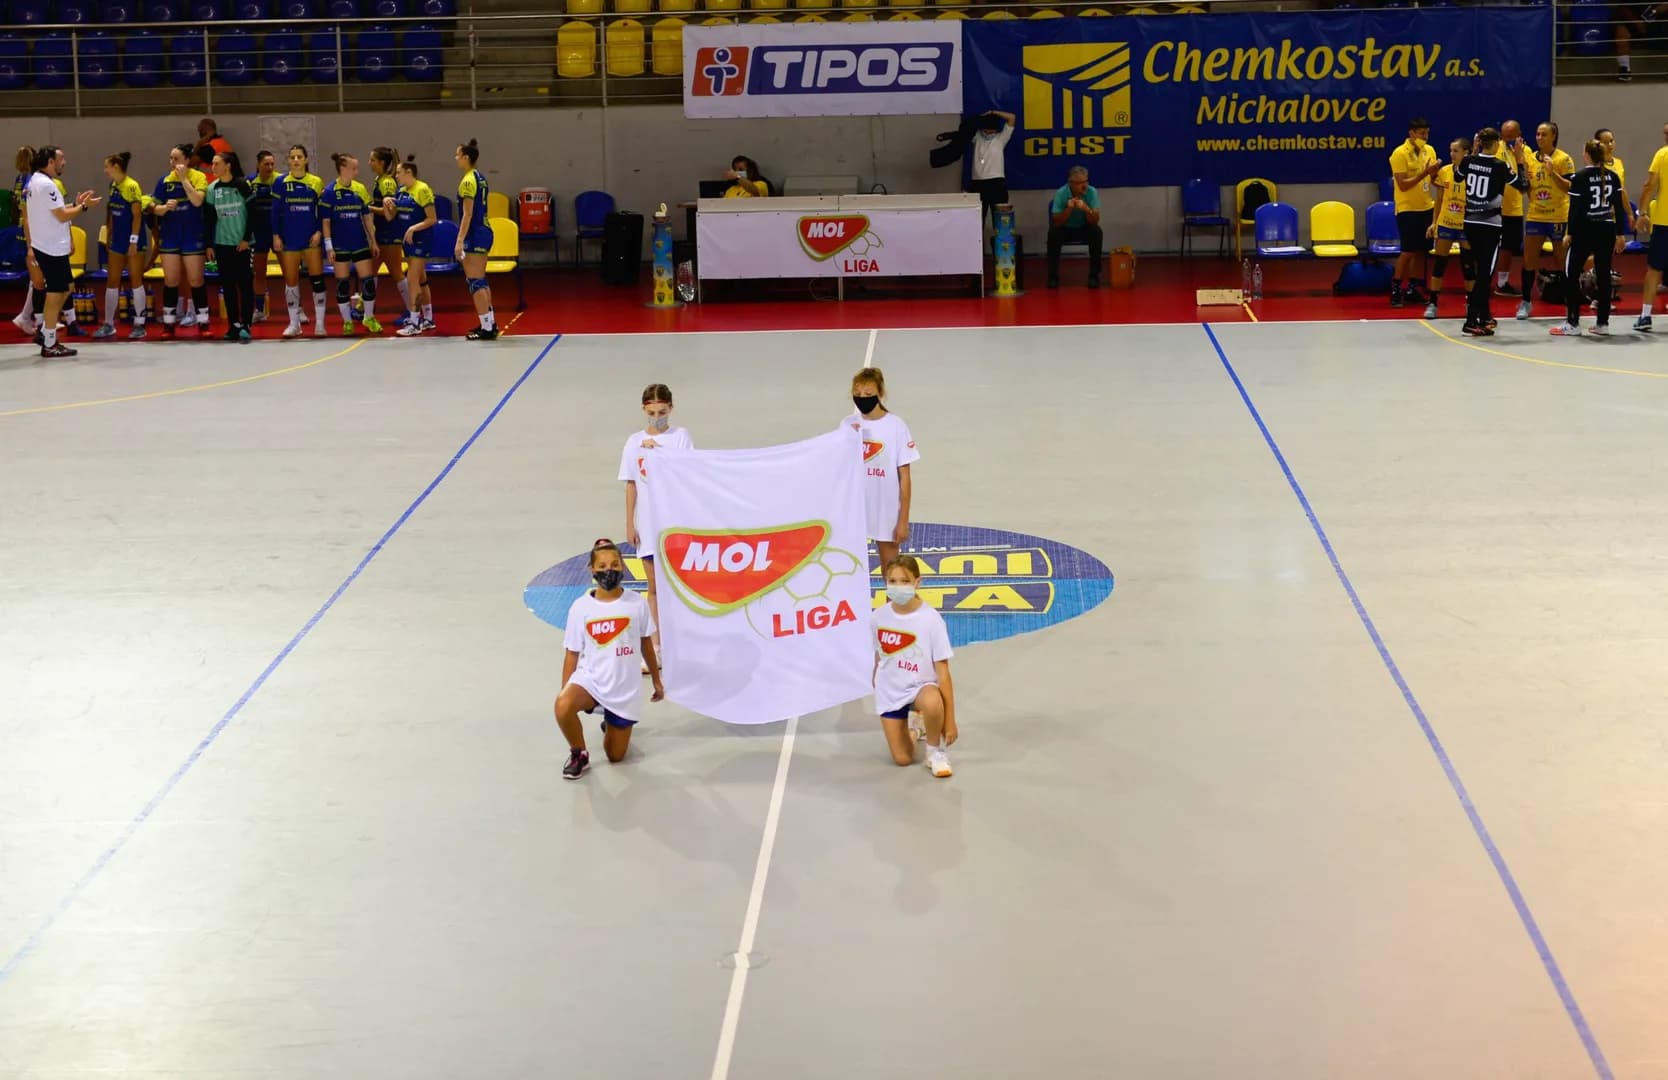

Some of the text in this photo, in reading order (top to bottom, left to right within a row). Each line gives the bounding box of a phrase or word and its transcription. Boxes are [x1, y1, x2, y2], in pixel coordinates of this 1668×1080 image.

[762, 47, 941, 89] TIPOS
[1142, 37, 1485, 83] Chemkostav, a.s.
[1196, 92, 1386, 125] Michalovce
[1023, 135, 1132, 156] CHST
[1196, 134, 1385, 151] www.chemkostav.eu
[286, 183, 294, 192] 11
[1466, 172, 1490, 198] 90
[1590, 184, 1613, 209] 32
[807, 222, 846, 238] MOL
[844, 259, 880, 273] LIGA
[867, 467, 886, 477] LIGA
[680, 540, 773, 573] MOL
[772, 599, 857, 638] LIGA
[591, 620, 616, 636] MOL
[880, 631, 902, 646] MOL
[615, 646, 634, 657] LIGA
[897, 659, 919, 673] LIGA
